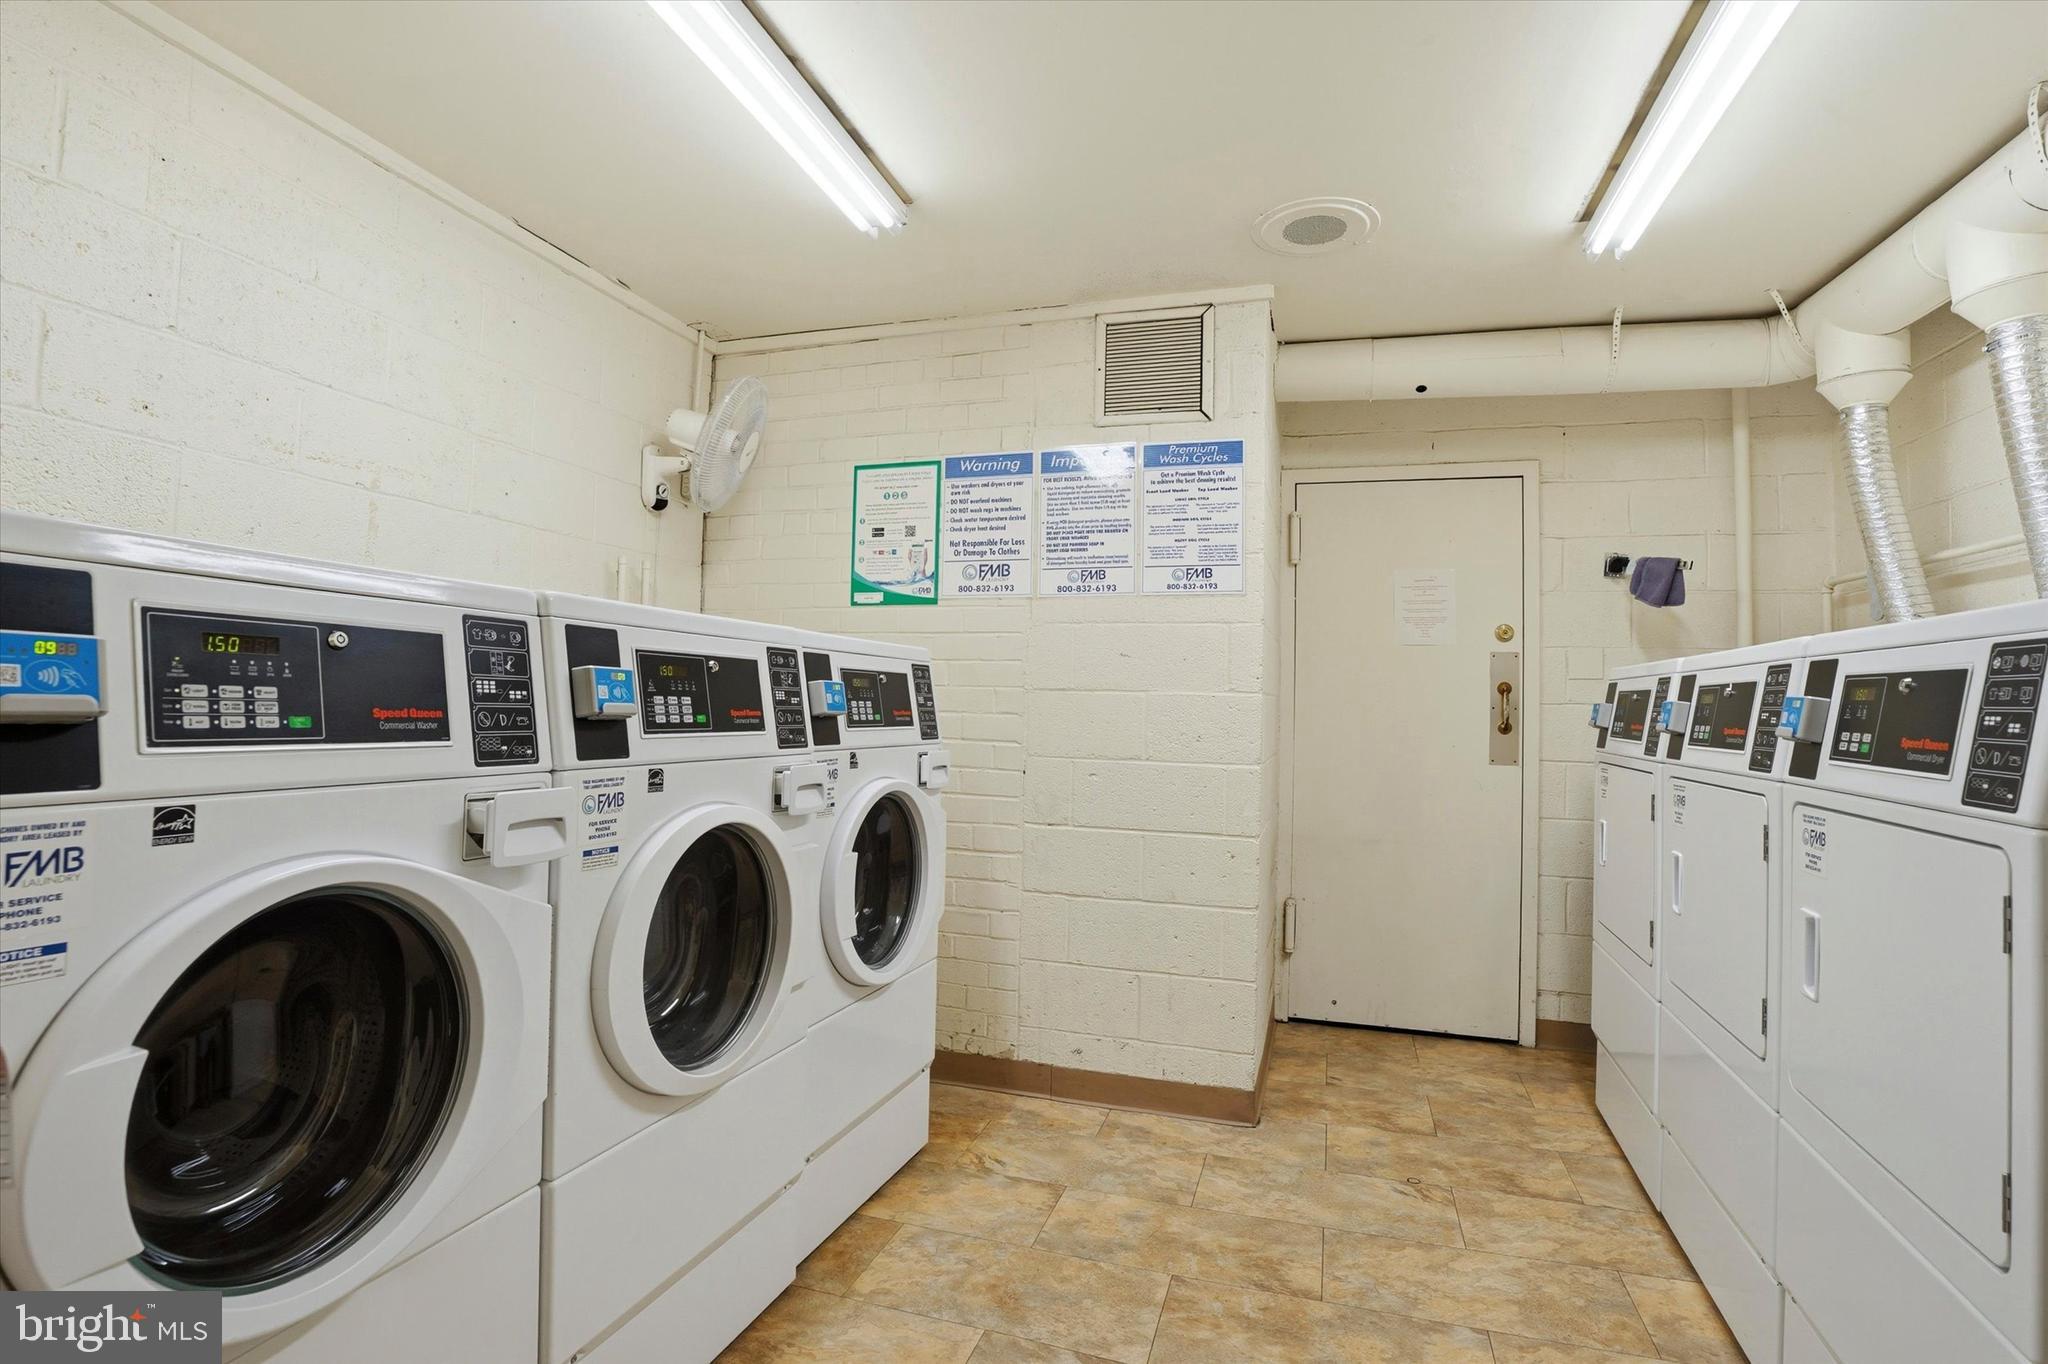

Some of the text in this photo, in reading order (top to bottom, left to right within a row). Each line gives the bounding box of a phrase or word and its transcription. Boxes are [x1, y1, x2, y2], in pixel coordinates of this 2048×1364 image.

[1169, 444, 1218, 454] Premium
[960, 458, 1020, 472] Warning
[1160, 451, 1228, 465] Wash Cycles
[962, 539, 998, 549] Responsible
[963, 548, 987, 558] Damage
[979, 564, 1010, 581] FMB
[1080, 570, 1106, 583] FMB
[1186, 568, 1212, 582] FMB
[1057, 584, 1116, 592] 800-832-6193
[372, 707, 443, 720] Speed Queen
[380, 721, 415, 729] Commercial
[1901, 737, 1949, 751] Speed Queen
[597, 792, 624, 814] FMB
[1810, 829, 1826, 848] FMB
[4, 846, 84, 888] FMB
[22, 873, 80, 888] LAUNDRY
[8, 893, 63, 907] SERVICE
[0, 907, 42, 919] PHONE
